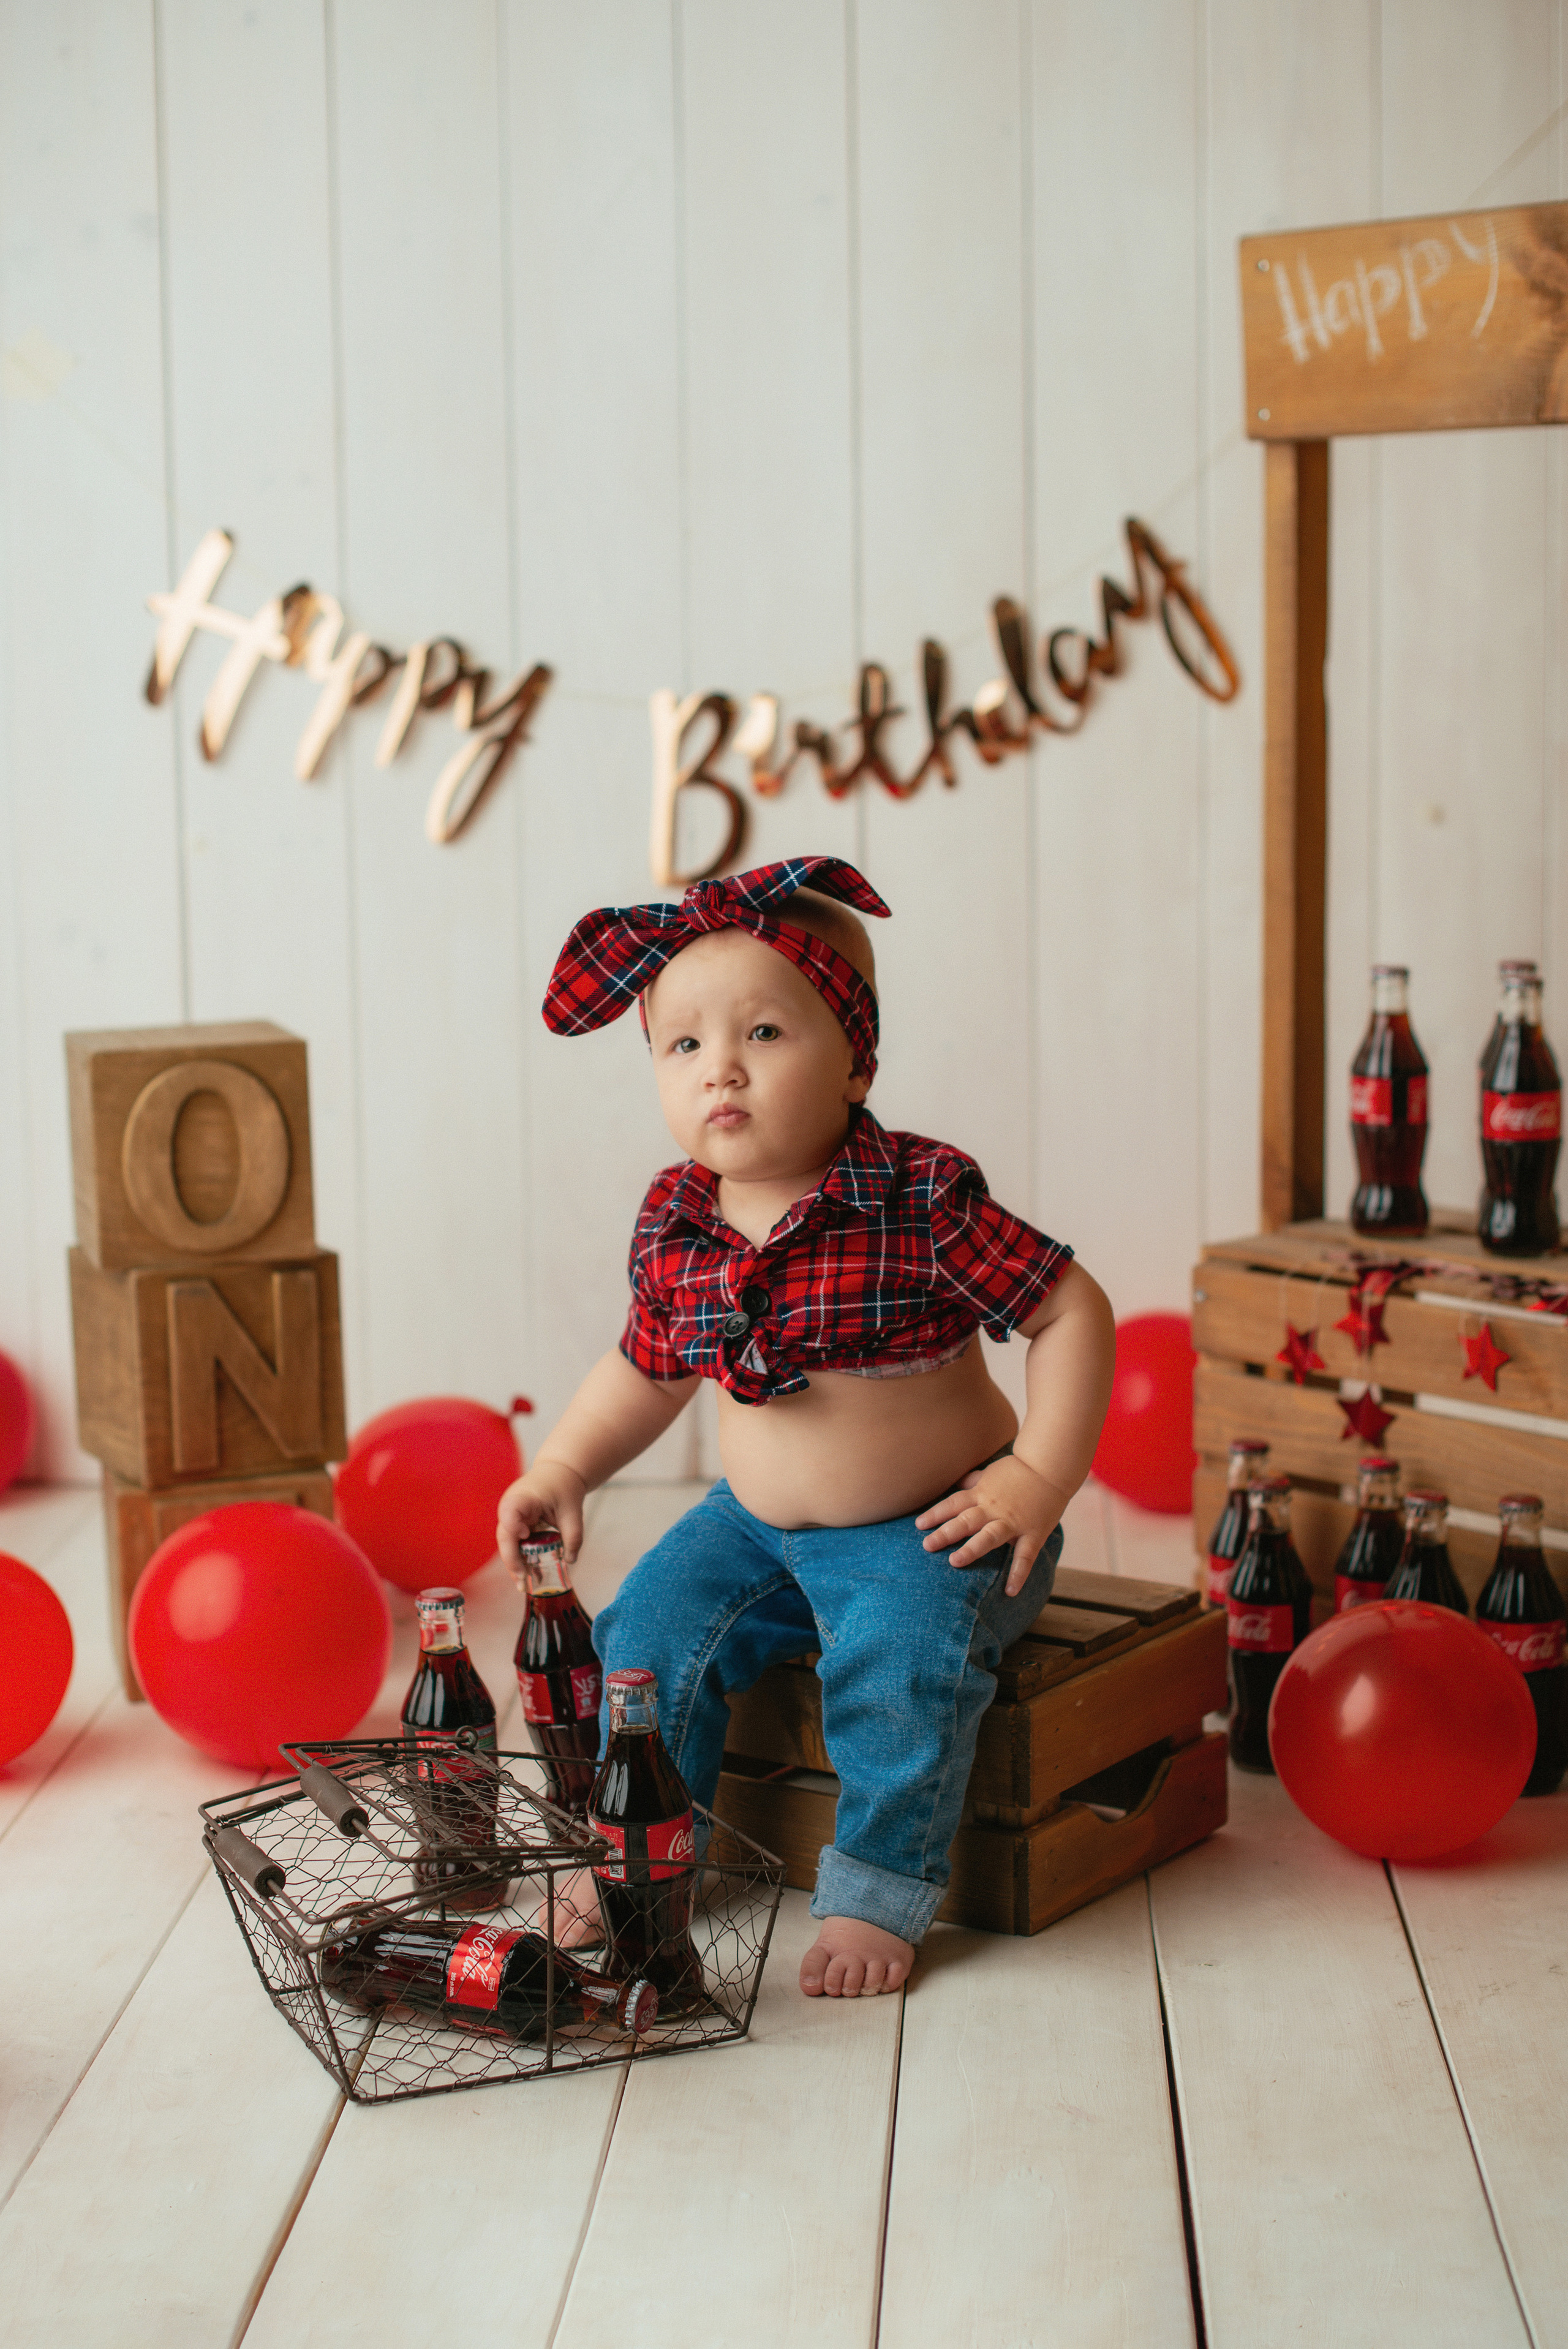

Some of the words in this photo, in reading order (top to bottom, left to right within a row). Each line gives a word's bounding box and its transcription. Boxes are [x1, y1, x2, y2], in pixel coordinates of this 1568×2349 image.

[1273, 216, 1499, 365] Happy
[146, 527, 555, 843] Happy
[649, 513, 1242, 887] Birthday
